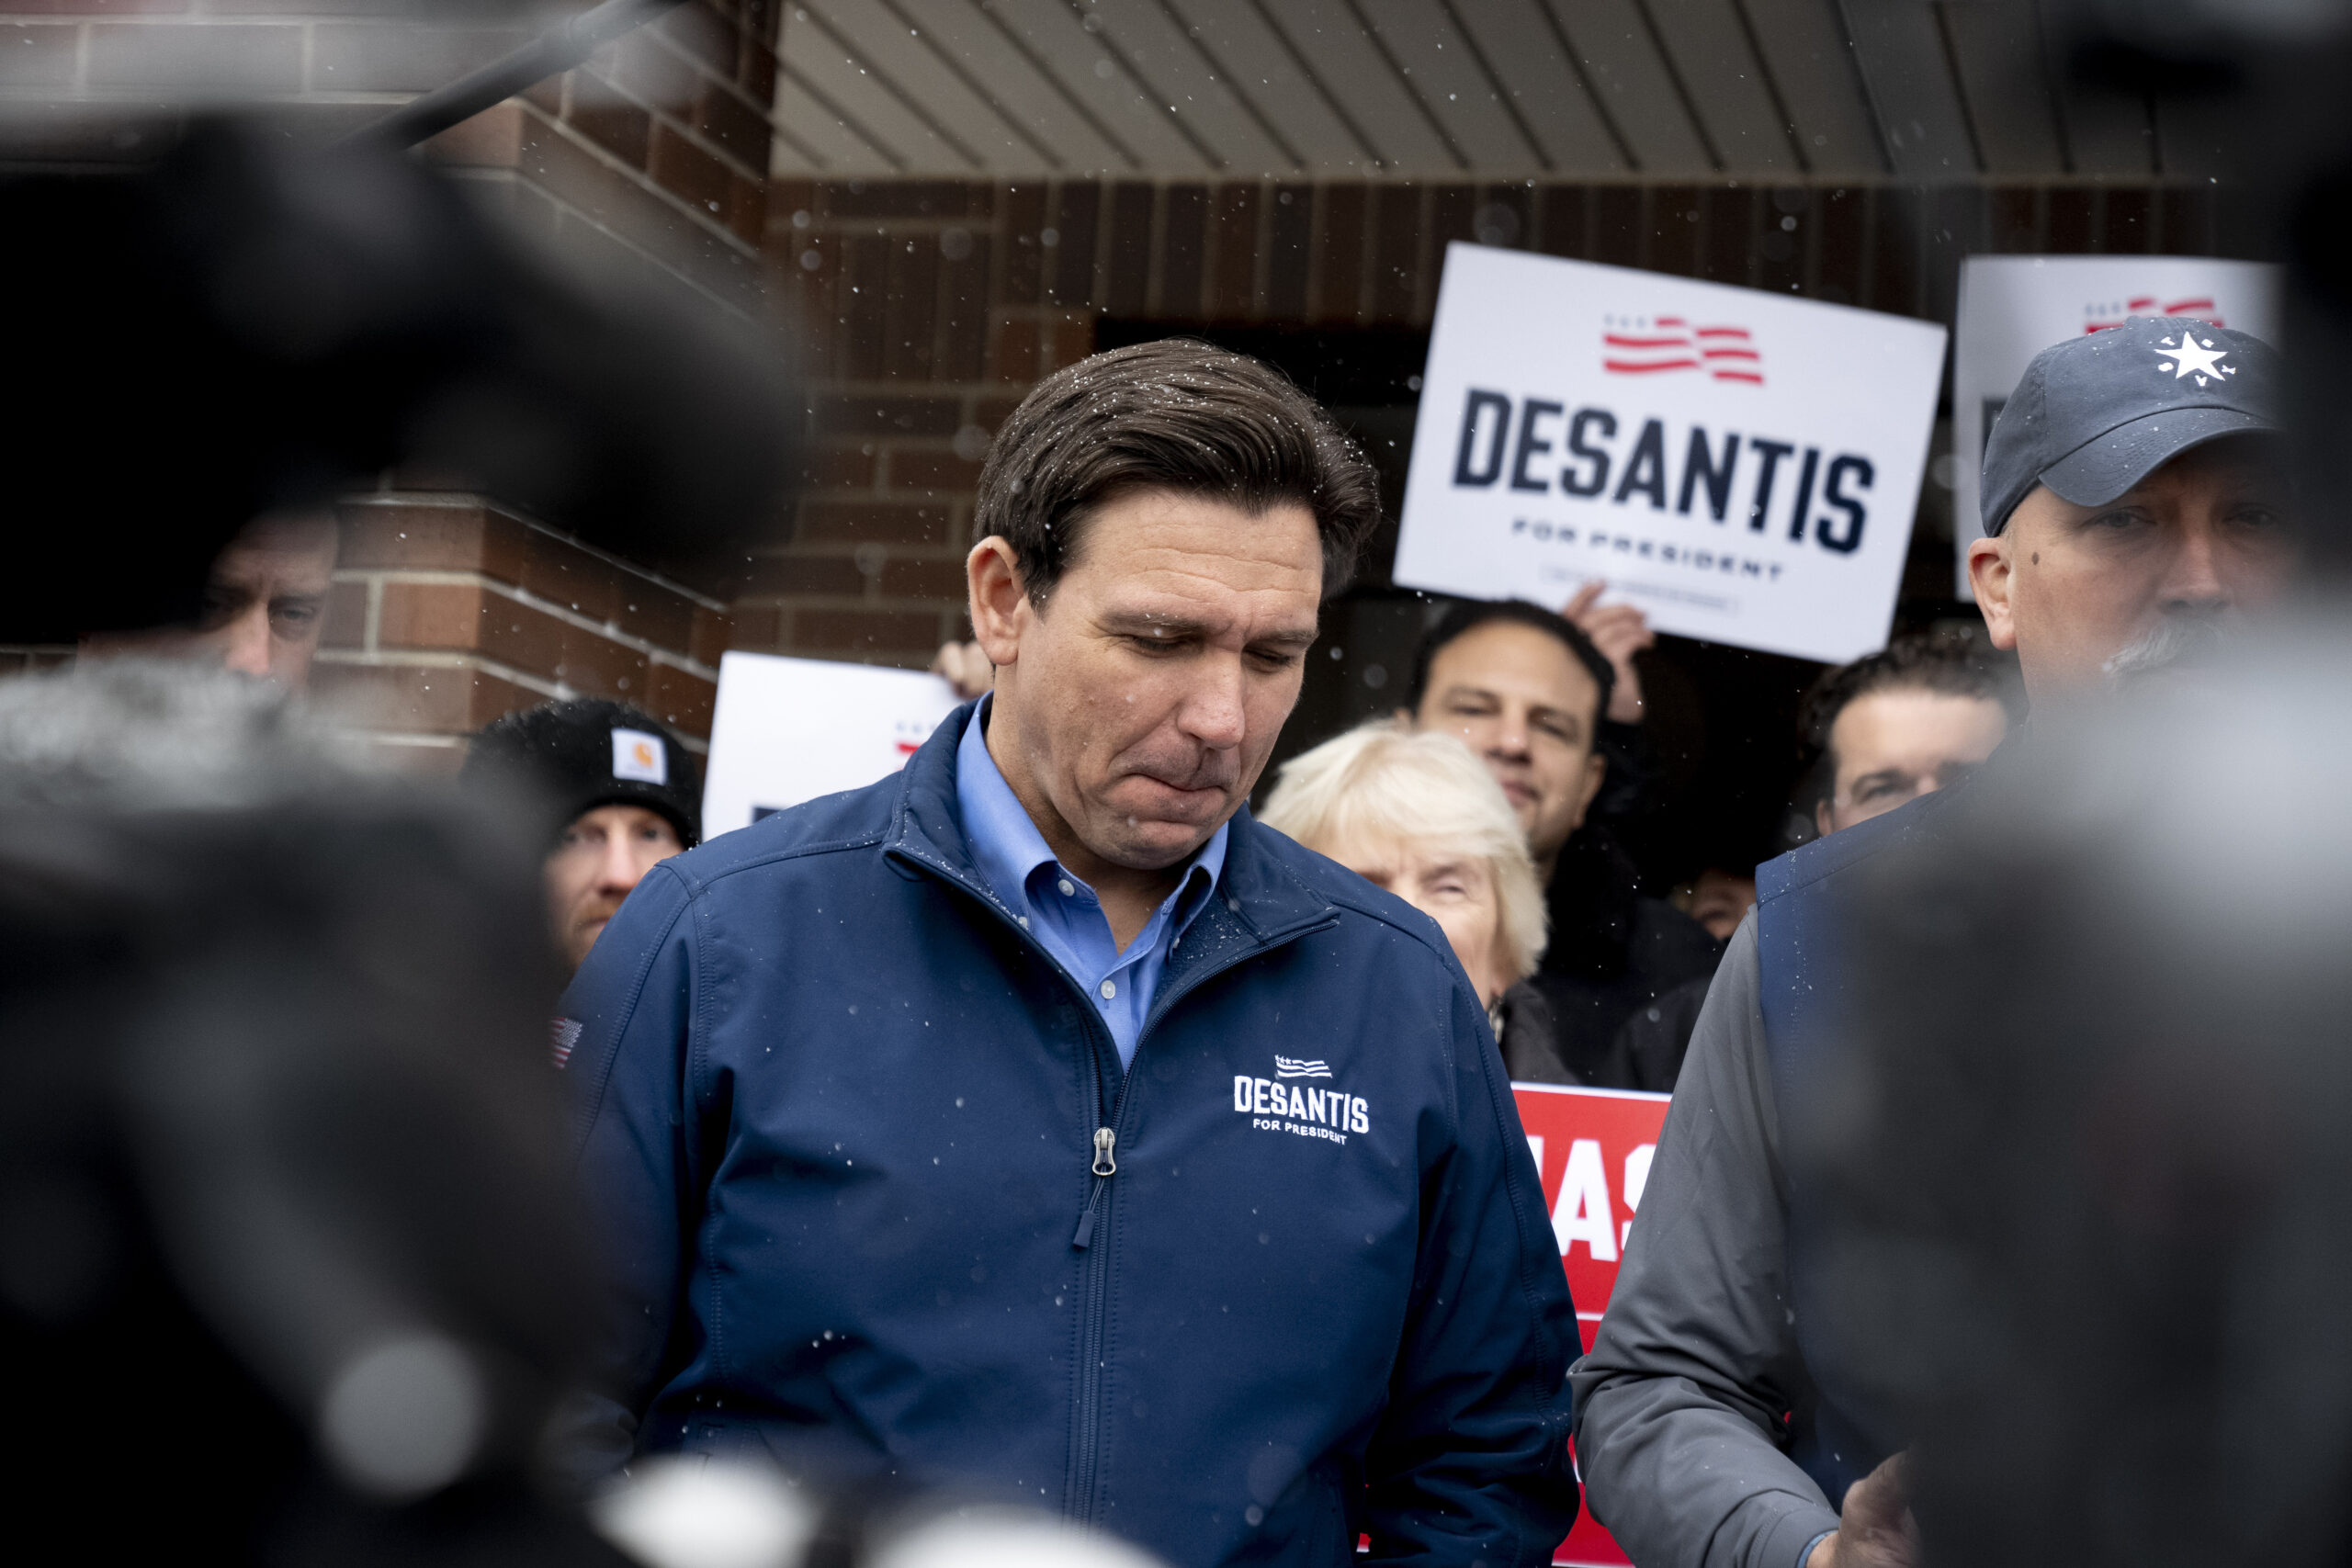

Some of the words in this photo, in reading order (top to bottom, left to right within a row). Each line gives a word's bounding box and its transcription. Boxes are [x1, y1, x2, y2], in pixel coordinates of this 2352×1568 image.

[1451, 388, 1876, 558] DESANTIS
[1511, 518, 1577, 542] FOR
[1589, 533, 1783, 581] PRESIDENT
[1234, 1075, 1370, 1134] DESANTIS
[1252, 1118, 1281, 1131] FOR
[1284, 1122, 1348, 1145] PRESIDENT
